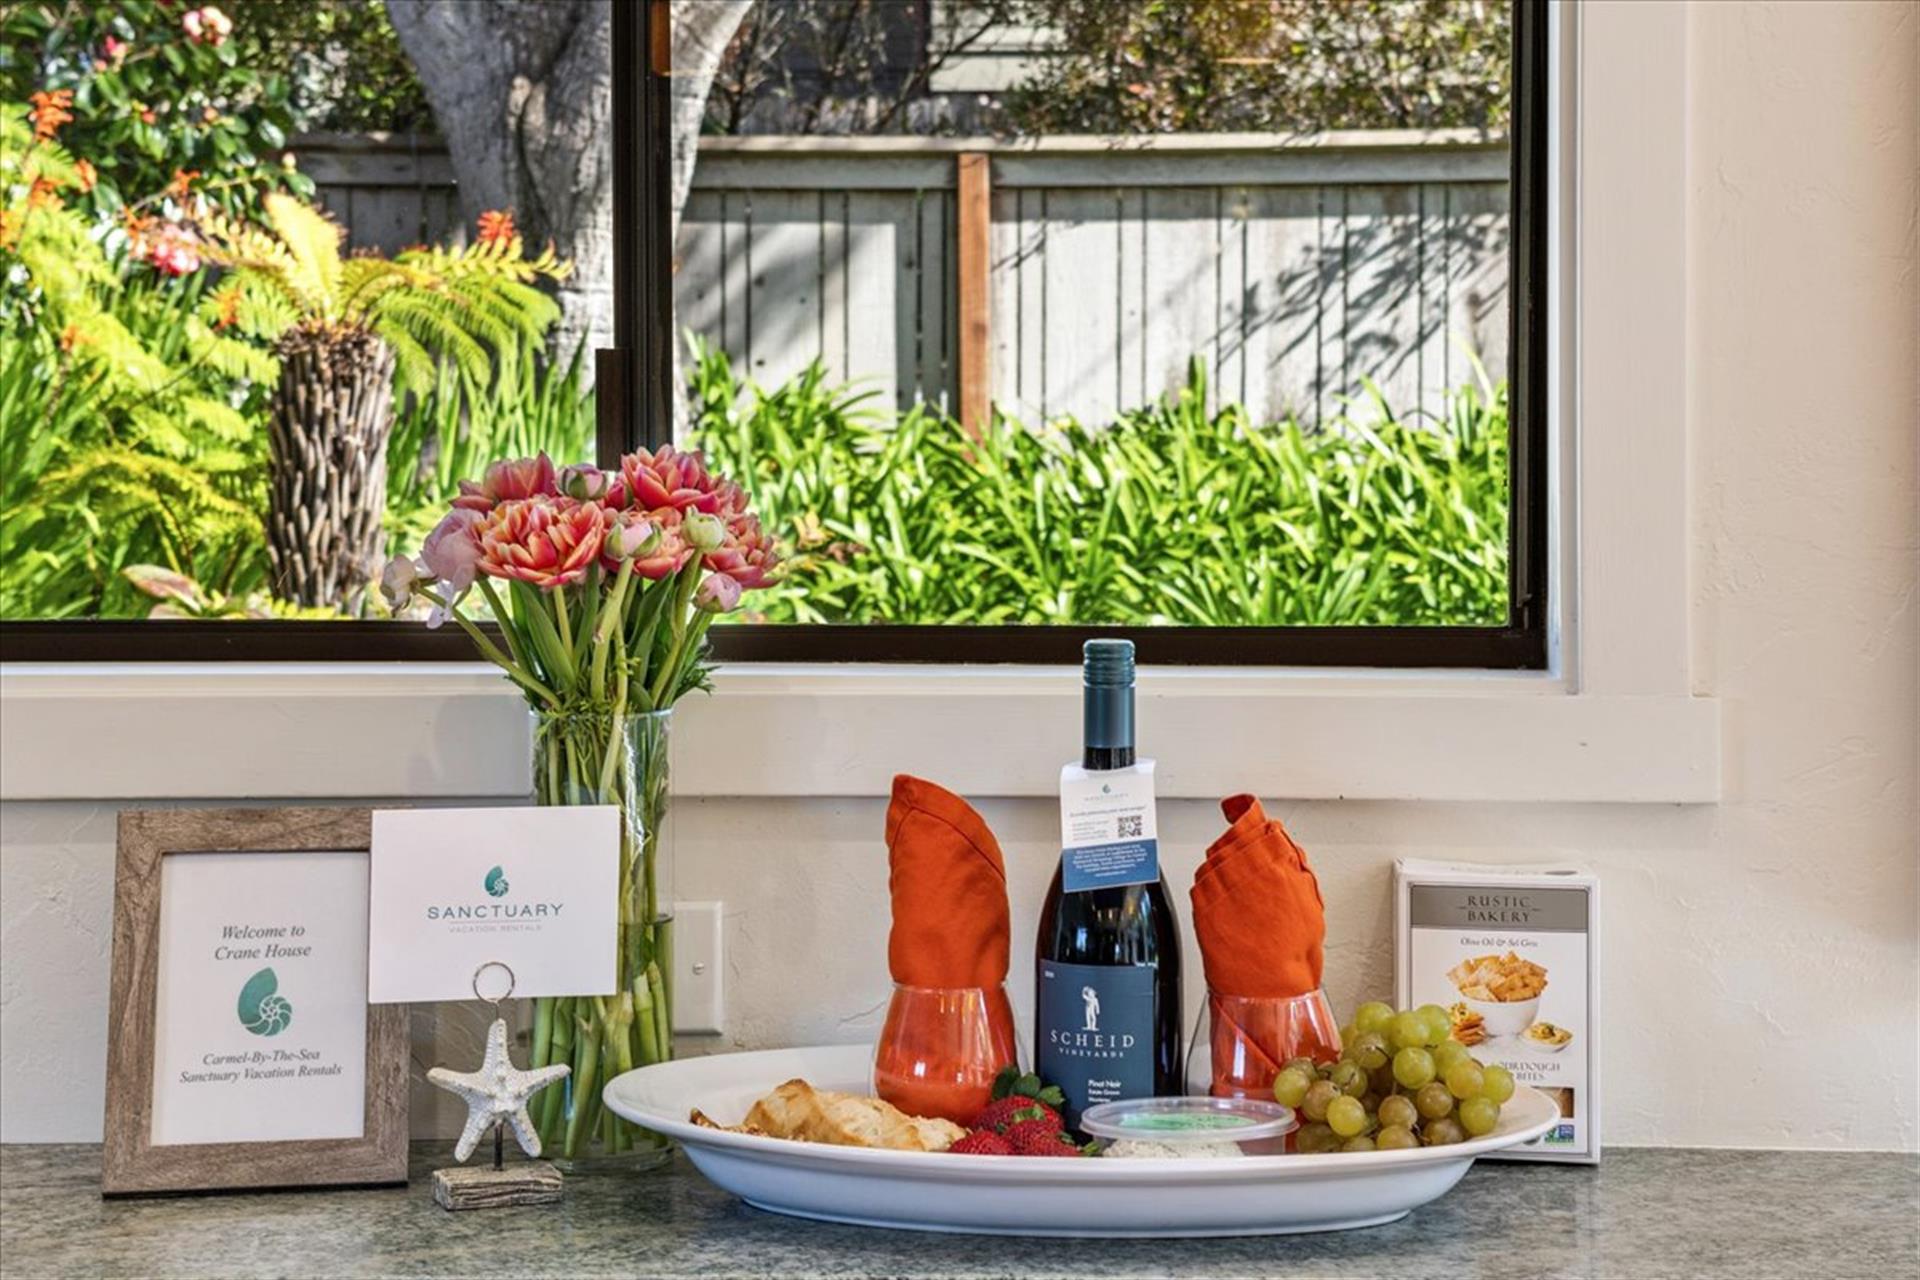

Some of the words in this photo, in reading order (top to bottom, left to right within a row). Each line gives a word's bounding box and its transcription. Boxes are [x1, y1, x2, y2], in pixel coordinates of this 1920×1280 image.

[1467, 895, 1531, 908] RUSTIC
[427, 903, 564, 920] SANCTUARY
[1467, 910, 1530, 923] BAKERY
[222, 925, 287, 940] Welcome
[290, 925, 306, 937] to
[500, 924, 542, 932] RENTALS
[214, 945, 261, 961] Crane
[264, 943, 312, 958] House
[1050, 1029, 1135, 1048] SCHEID
[202, 1048, 320, 1066] Carmel-By-The-Sea
[1059, 1047, 1125, 1058] VINEYARDS
[179, 1070, 241, 1084] Sanctuary
[244, 1066, 295, 1080] Vacation
[298, 1063, 343, 1077] Rentals
[1088, 1079, 1105, 1088] Pinot
[1106, 1079, 1122, 1088] Noir
